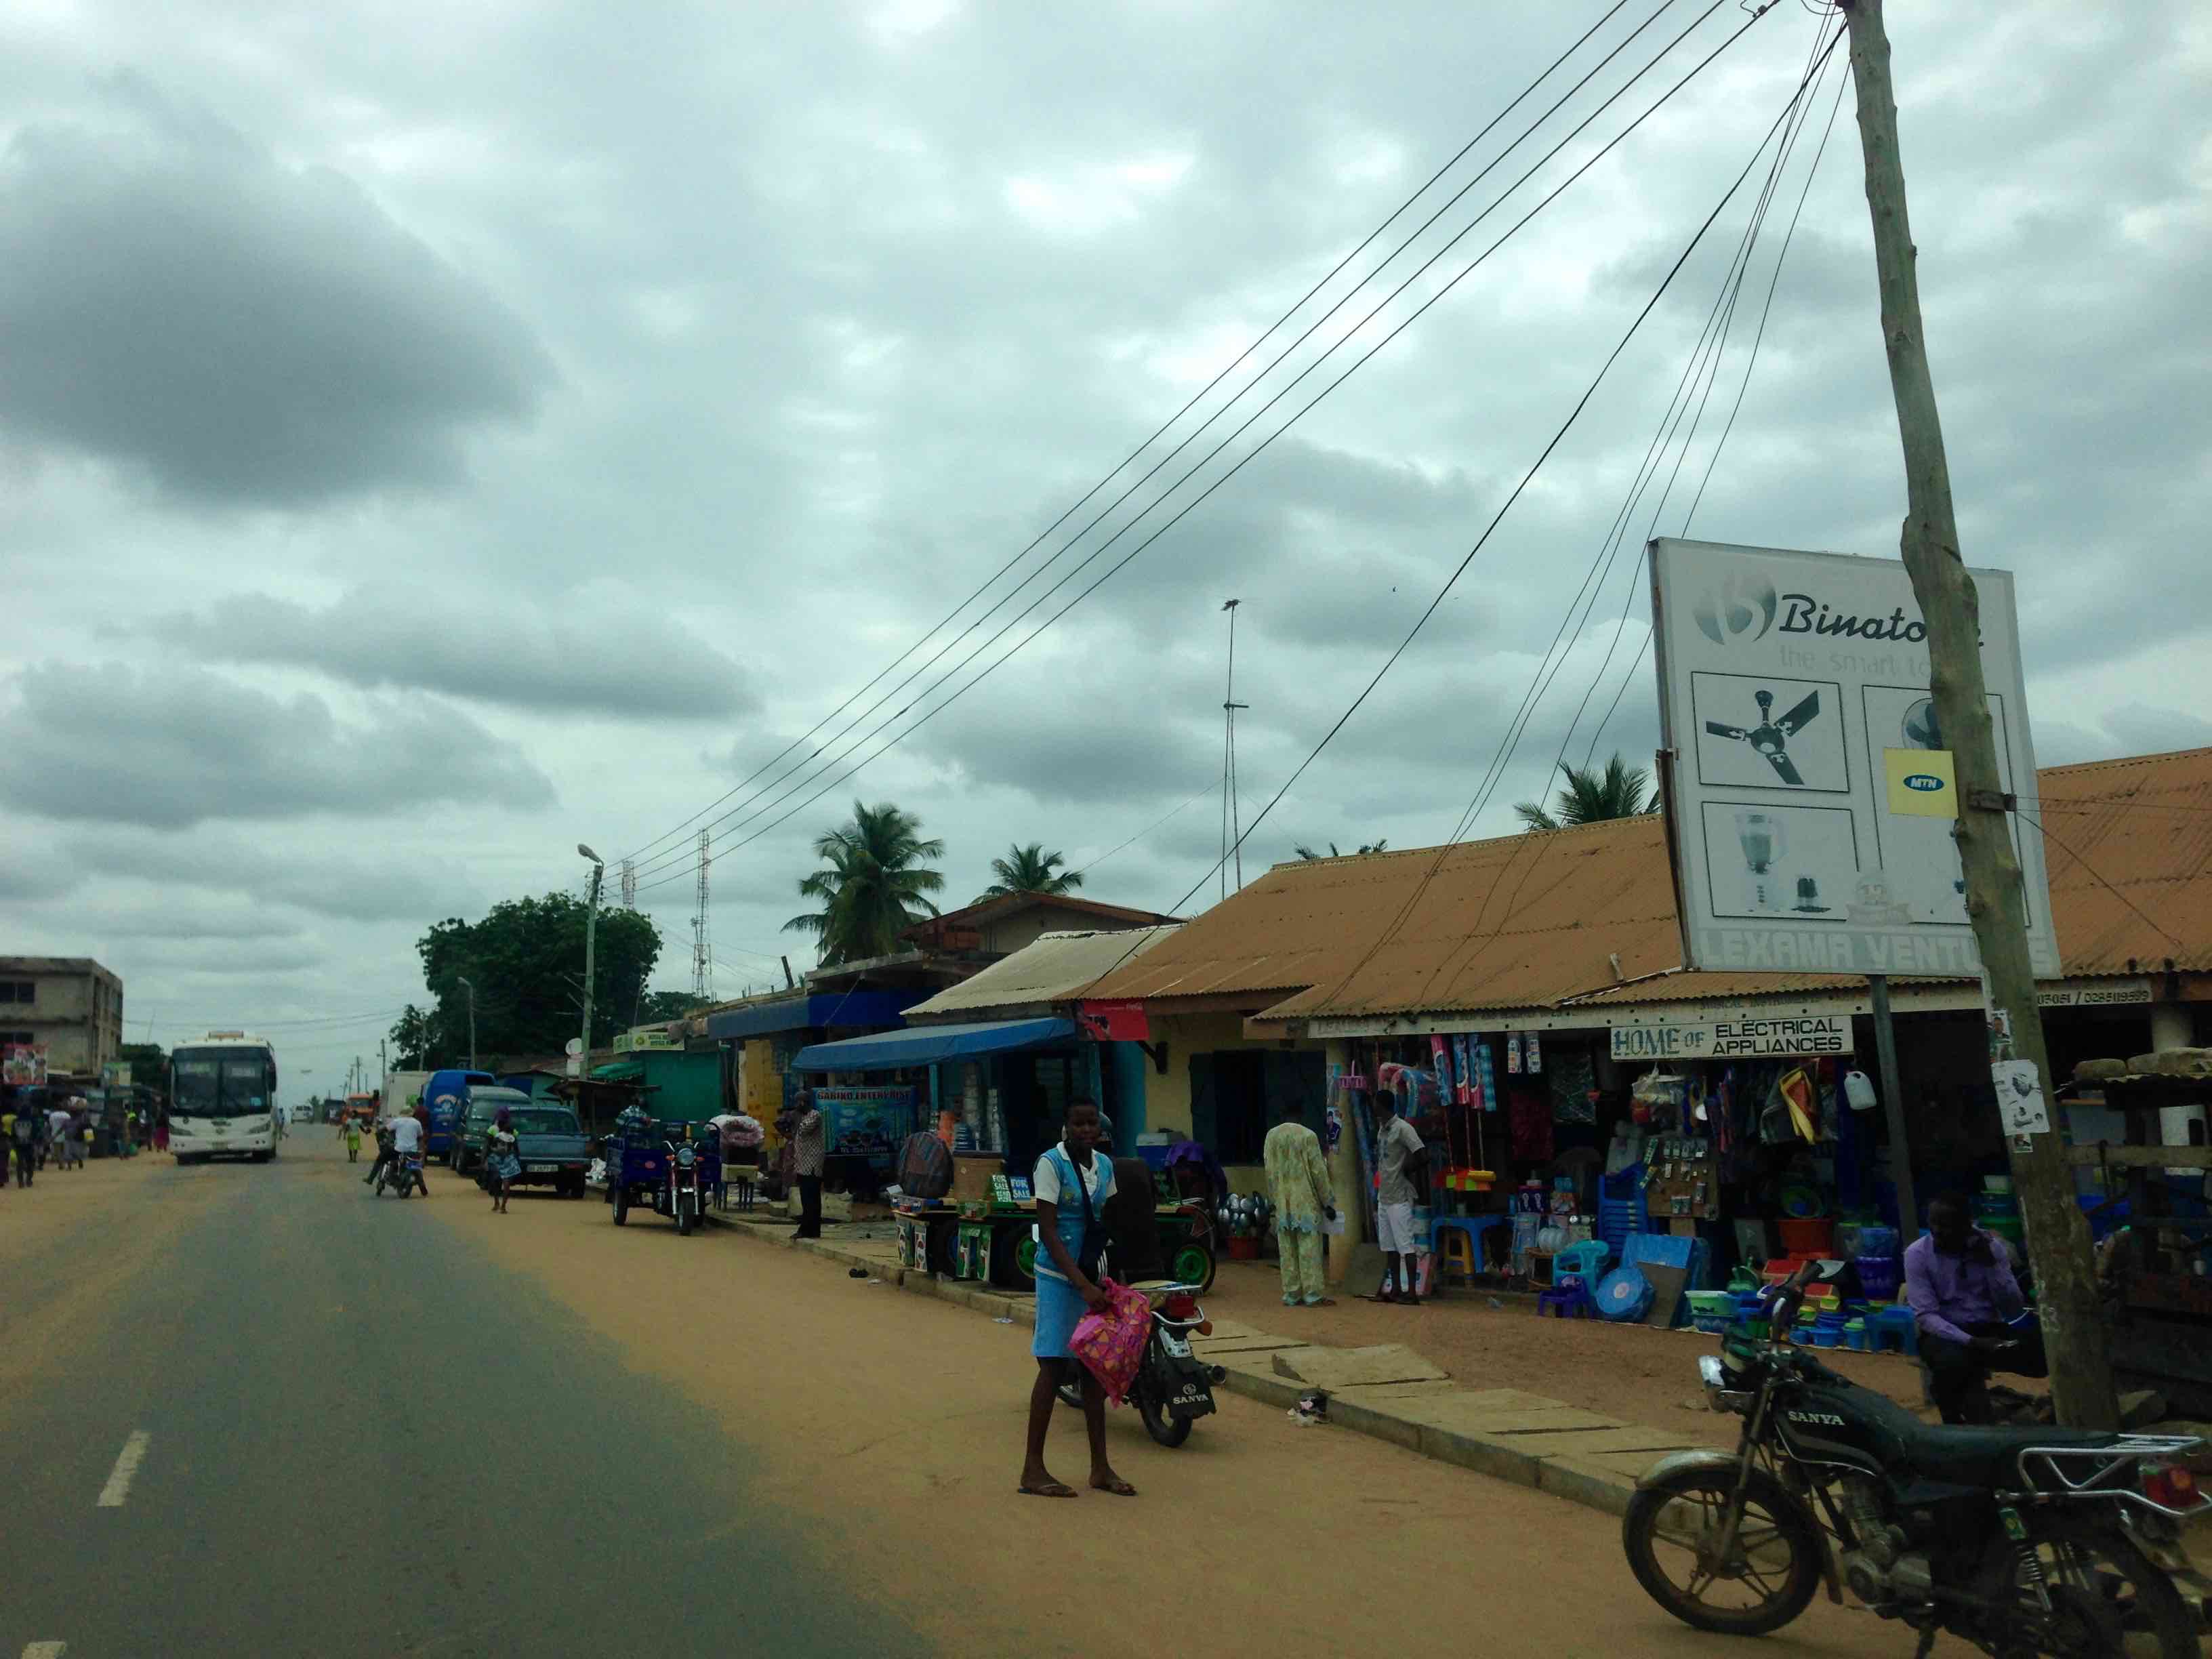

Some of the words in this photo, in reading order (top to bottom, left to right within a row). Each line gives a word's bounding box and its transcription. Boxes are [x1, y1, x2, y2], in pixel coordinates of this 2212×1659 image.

[1779, 594, 1984, 647] Binato
[1780, 646, 1816, 670] the
[1830, 651, 1898, 676] smart
[1910, 777, 1938, 789] MTN
[1700, 929, 1855, 968] LEXAMA
[1867, 931, 2054, 974] VENTUS
[1715, 1018, 1843, 1038] ELECTRICAL
[1614, 1028, 1681, 1057] HOME
[1684, 1030, 1704, 1048] OF
[1713, 1037, 1842, 1054] APPLIANCES
[991, 1174, 1007, 1183] FOR
[1010, 1178, 1029, 1188] FOR
[1012, 1188, 1031, 1198] SALE
[1788, 1410, 1845, 1426] SANYA
